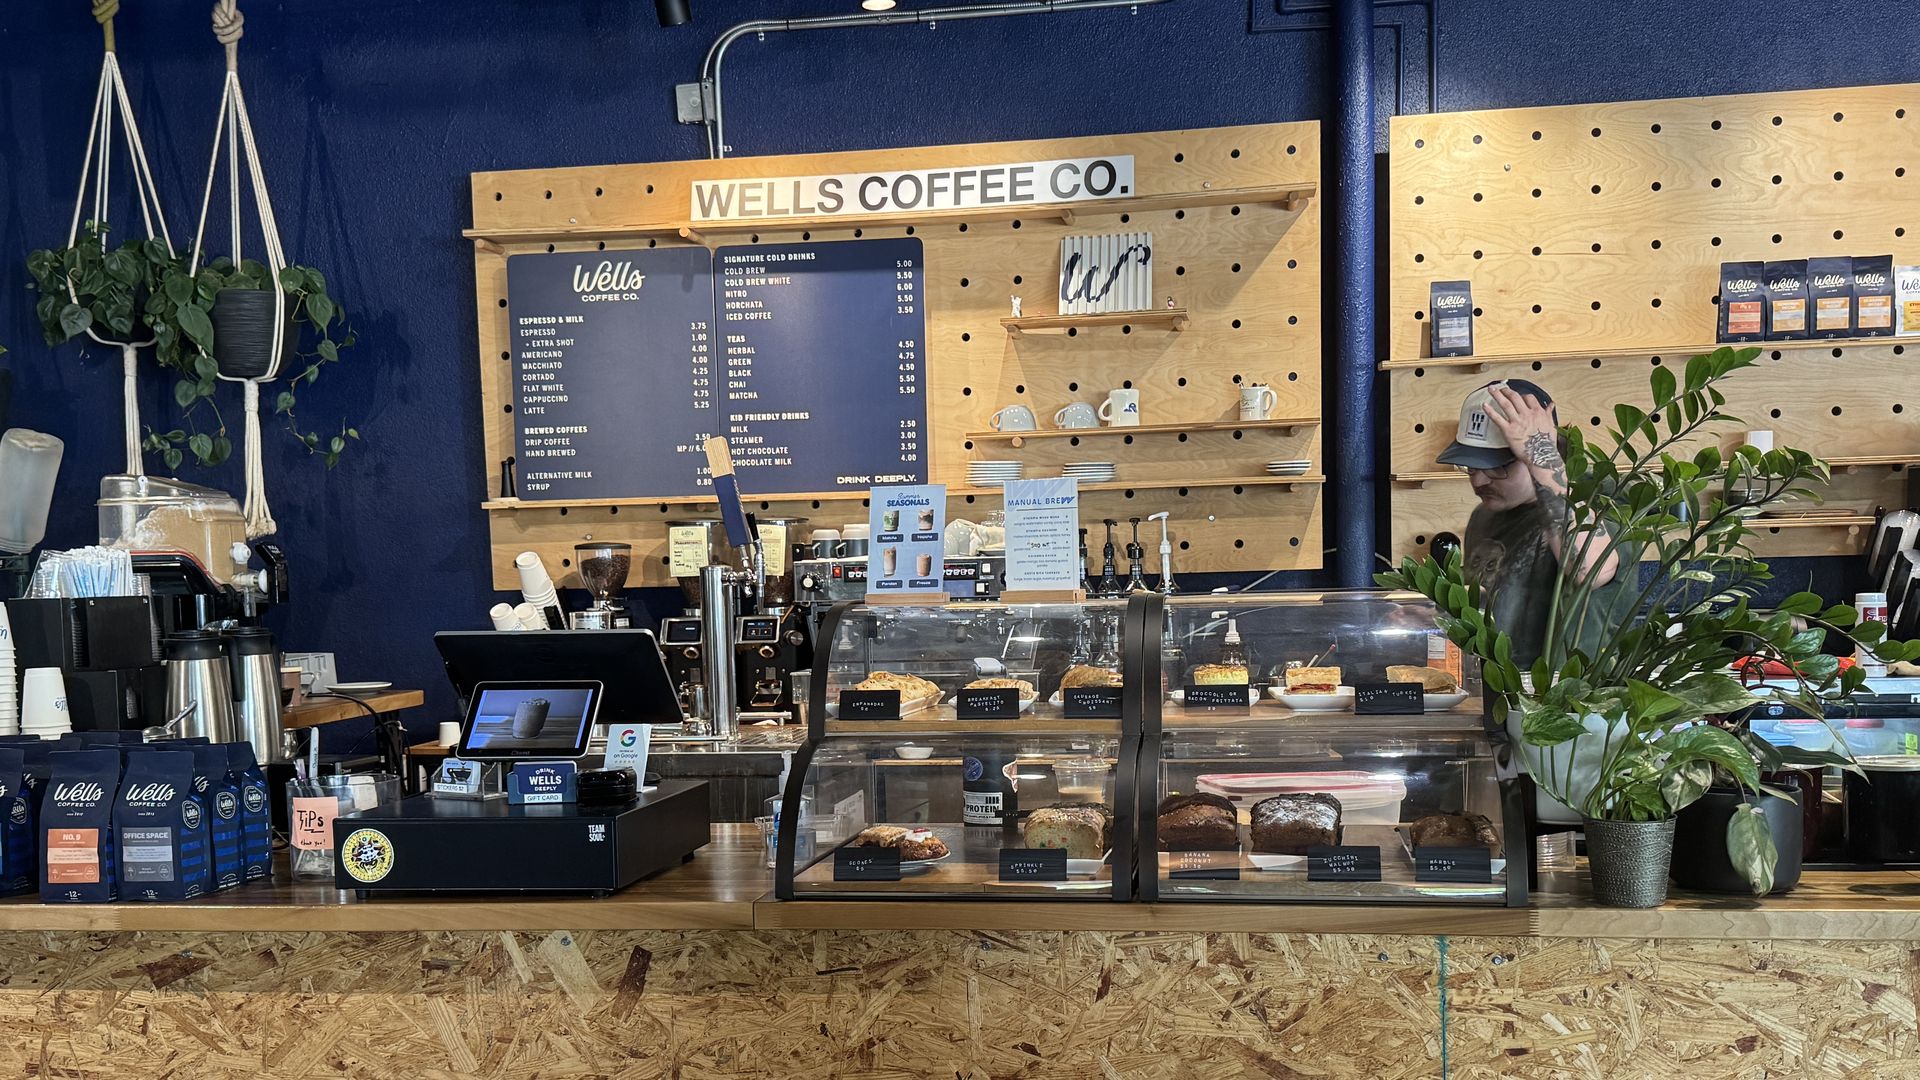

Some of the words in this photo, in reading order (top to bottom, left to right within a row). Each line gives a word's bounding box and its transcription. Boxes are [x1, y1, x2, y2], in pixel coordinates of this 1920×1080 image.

[695, 178, 844, 219] WELLS
[858, 166, 1035, 212] COFFEE
[1049, 159, 1129, 200] CO.
[724, 255, 765, 264] SIGNATURE
[766, 253, 786, 262] COLD
[788, 252, 816, 261] DRINKS
[724, 267, 743, 276] COLD
[745, 266, 766, 275] BREW
[896, 260, 913, 268] 5.00
[573, 260, 646, 293] Wells
[724, 278, 744, 287] COLD
[745, 277, 766, 286] BREW
[768, 276, 791, 285] WHITE
[896, 271, 913, 280] 5.50
[1814, 274, 1846, 286] Wells
[1855, 273, 1886, 284] Wells
[1727, 279, 1758, 290] Wells
[1770, 277, 1801, 290] Wells
[725, 290, 748, 298] NITRO
[896, 283, 913, 291] 6.00
[582, 294, 621, 302] COFFEE
[622, 293, 640, 301] CO.
[725, 301, 763, 310] HORCHATA
[897, 294, 914, 303] 5.50
[1437, 296, 1467, 306] Wells
[519, 317, 557, 325] ESPRESSO
[565, 315, 585, 323] MILK
[726, 313, 743, 321] ICED
[744, 311, 772, 320] COFFEE
[897, 306, 914, 314] 3.50
[520, 328, 556, 337] ESPRESSO
[691, 322, 707, 331] 3.75
[532, 340, 554, 348] EXTRA
[556, 338, 574, 347] SHOT
[691, 334, 707, 342] 1.00
[727, 335, 746, 343] TEAS
[521, 351, 563, 359] AMERICANO
[691, 345, 708, 353] 4.00
[727, 347, 756, 355] HERBAL
[898, 340, 915, 349] 4.50
[522, 361, 563, 370] MACCHIATO
[692, 356, 708, 364] 4.00
[728, 358, 752, 366] GREEN
[898, 352, 915, 360] 4.75
[522, 373, 555, 382] CORTADO
[692, 367, 708, 376] 4.25
[728, 369, 752, 378] BLACK
[899, 363, 915, 372] 4.50
[523, 385, 540, 393] FLAT
[541, 383, 564, 392] WHITE
[693, 378, 709, 387] 4.75
[729, 381, 746, 389] CHAI
[899, 374, 915, 383] 5.50
[523, 395, 569, 403] CAPPUCCINO
[693, 390, 710, 398] 4.75
[729, 392, 758, 400] MATCHA
[899, 386, 916, 394] 5.50
[524, 407, 545, 415] LATTE
[694, 401, 710, 409] 5.25
[730, 414, 743, 422] KID
[744, 413, 780, 421] FRIENDLY
[781, 411, 810, 420] DRINKS
[524, 427, 555, 435] BREWED
[556, 426, 588, 434] COFFEES
[730, 425, 748, 434] MILK
[900, 420, 916, 428] 2.50
[525, 438, 542, 447] DRIP
[544, 437, 570, 446] COFFEE
[695, 433, 711, 442] 3.50
[730, 436, 764, 445] STEAMER
[900, 431, 917, 439] 3.00
[525, 450, 546, 458] HAND
[547, 448, 577, 457] BREWED
[677, 445, 688, 453] MP
[731, 448, 745, 456] HOT
[747, 446, 789, 455] CHOCOLATE
[900, 442, 917, 451] 3.50
[732, 459, 773, 467] CHOCOLATE
[774, 457, 792, 466] MILK
[900, 454, 917, 462] 4.00
[527, 472, 574, 480] ALTERNATIVE
[575, 471, 593, 479] MILK
[697, 467, 712, 476] 1.00
[836, 475, 871, 484] DRINK
[874, 474, 917, 483] DEEPLY.
[527, 483, 551, 491] SYRUP
[696, 478, 713, 487] 0.80
[886, 498, 930, 508] SEASONALS
[1007, 499, 1042, 507] MANUAL
[1045, 496, 1075, 505] BREW
[967, 694, 1001, 703] BREAKFAST
[1358, 689, 1388, 697] ITALIAN
[969, 699, 1005, 708] PASTELITO
[620, 752, 639, 760] Google
[535, 767, 556, 775] DRINK
[528, 775, 562, 786] WELLS
[54, 782, 105, 802] Wells
[126, 782, 176, 802] Wells
[966, 804, 999, 813] PROTEIN
[123, 832, 145, 840] OFFICE
[145, 831, 169, 839] SPACE
[588, 824, 606, 834] TEAM
[62, 833, 76, 841] NO.
[1323, 854, 1359, 864] ZUCCHINI
[1328, 860, 1355, 868] WALNUT
